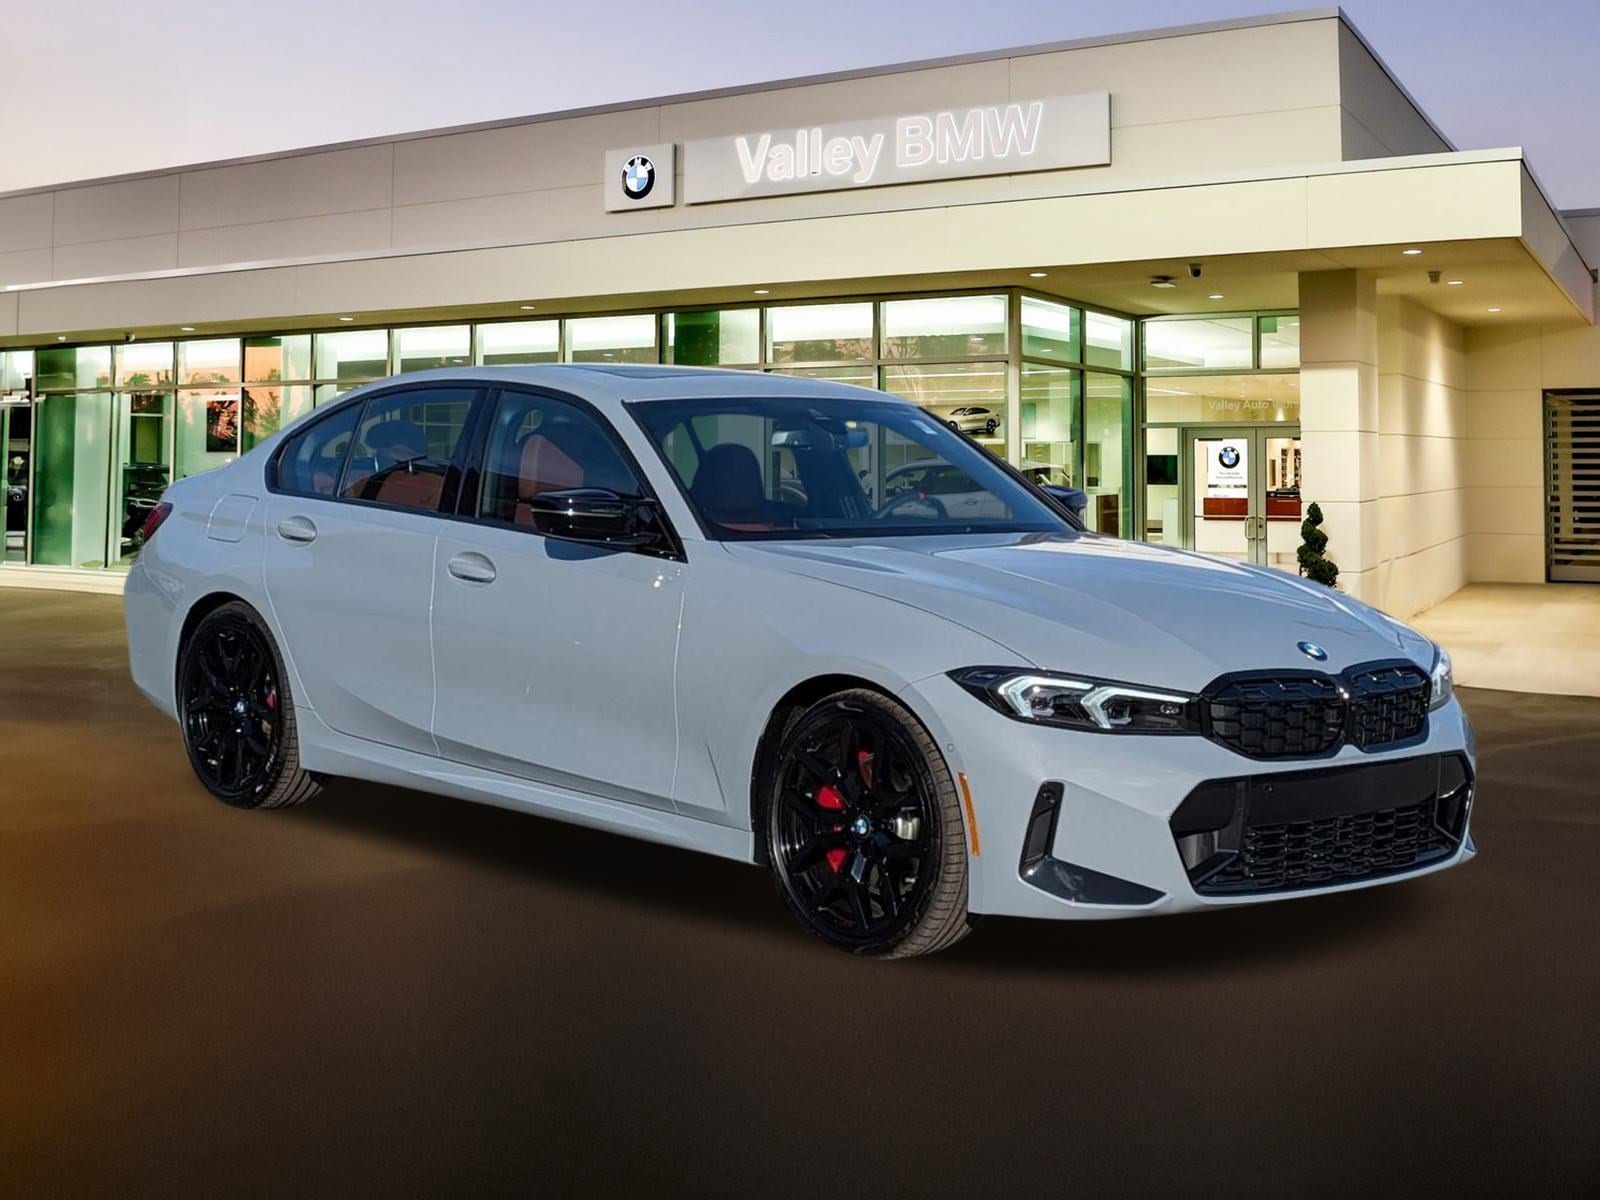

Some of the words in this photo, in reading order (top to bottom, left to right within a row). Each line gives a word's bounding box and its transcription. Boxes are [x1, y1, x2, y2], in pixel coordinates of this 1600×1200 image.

[735, 127, 885, 184] Valley
[896, 101, 1043, 167] BMW
[1208, 399, 1240, 412] Valley
[1243, 399, 1270, 409] Auto
